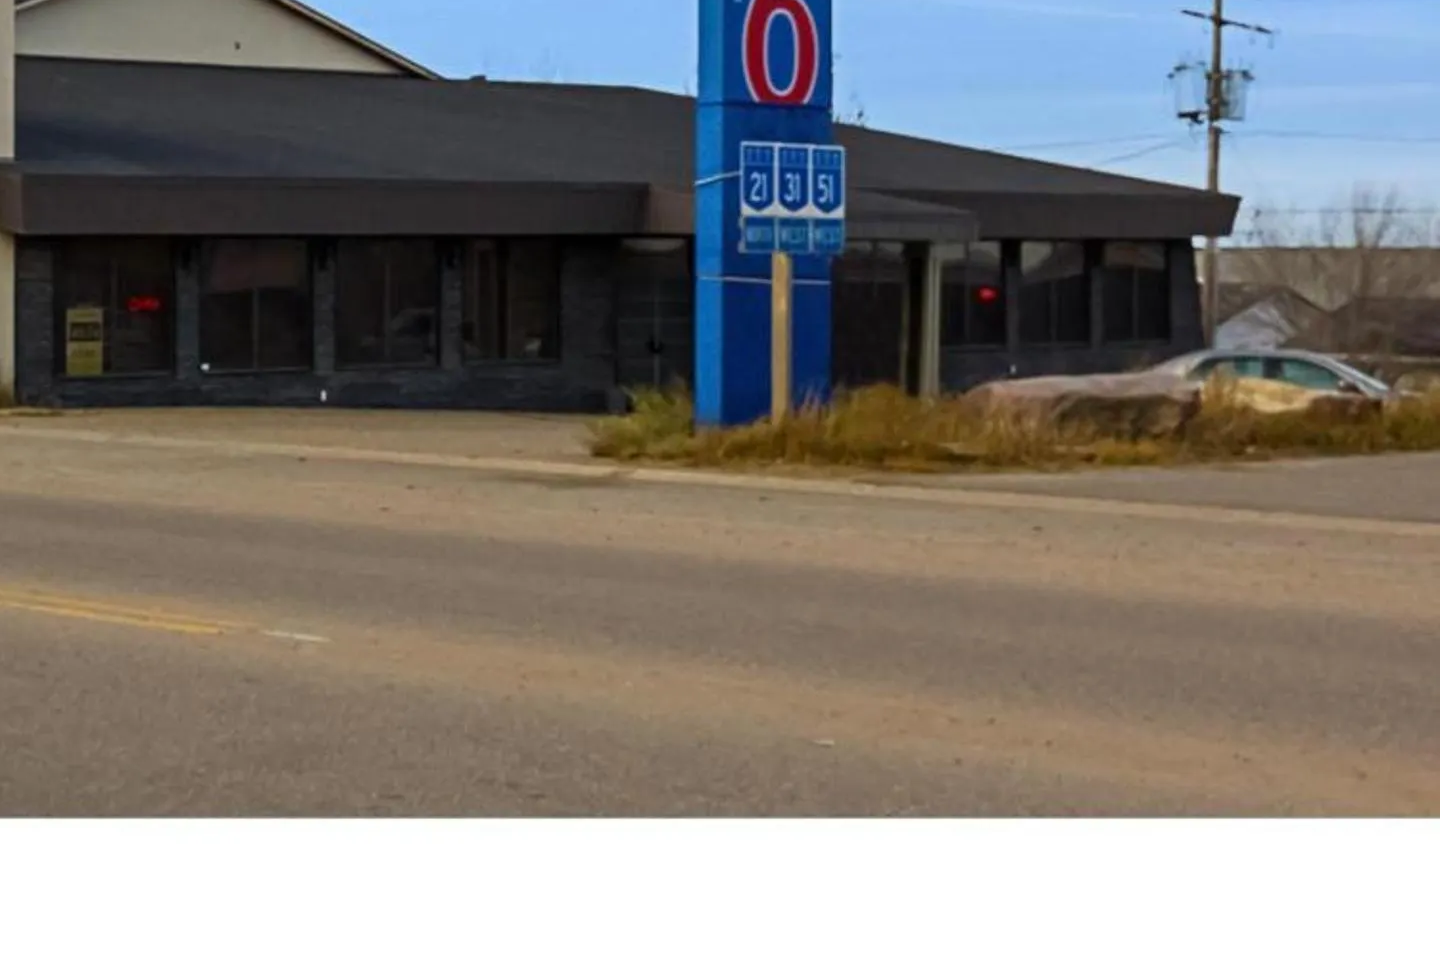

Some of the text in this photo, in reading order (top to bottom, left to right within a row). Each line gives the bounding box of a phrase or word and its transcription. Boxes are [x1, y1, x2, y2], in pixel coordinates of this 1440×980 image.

[750, 171, 767, 202] 21
[783, 172, 801, 203] 31
[817, 173, 834, 204] 51
